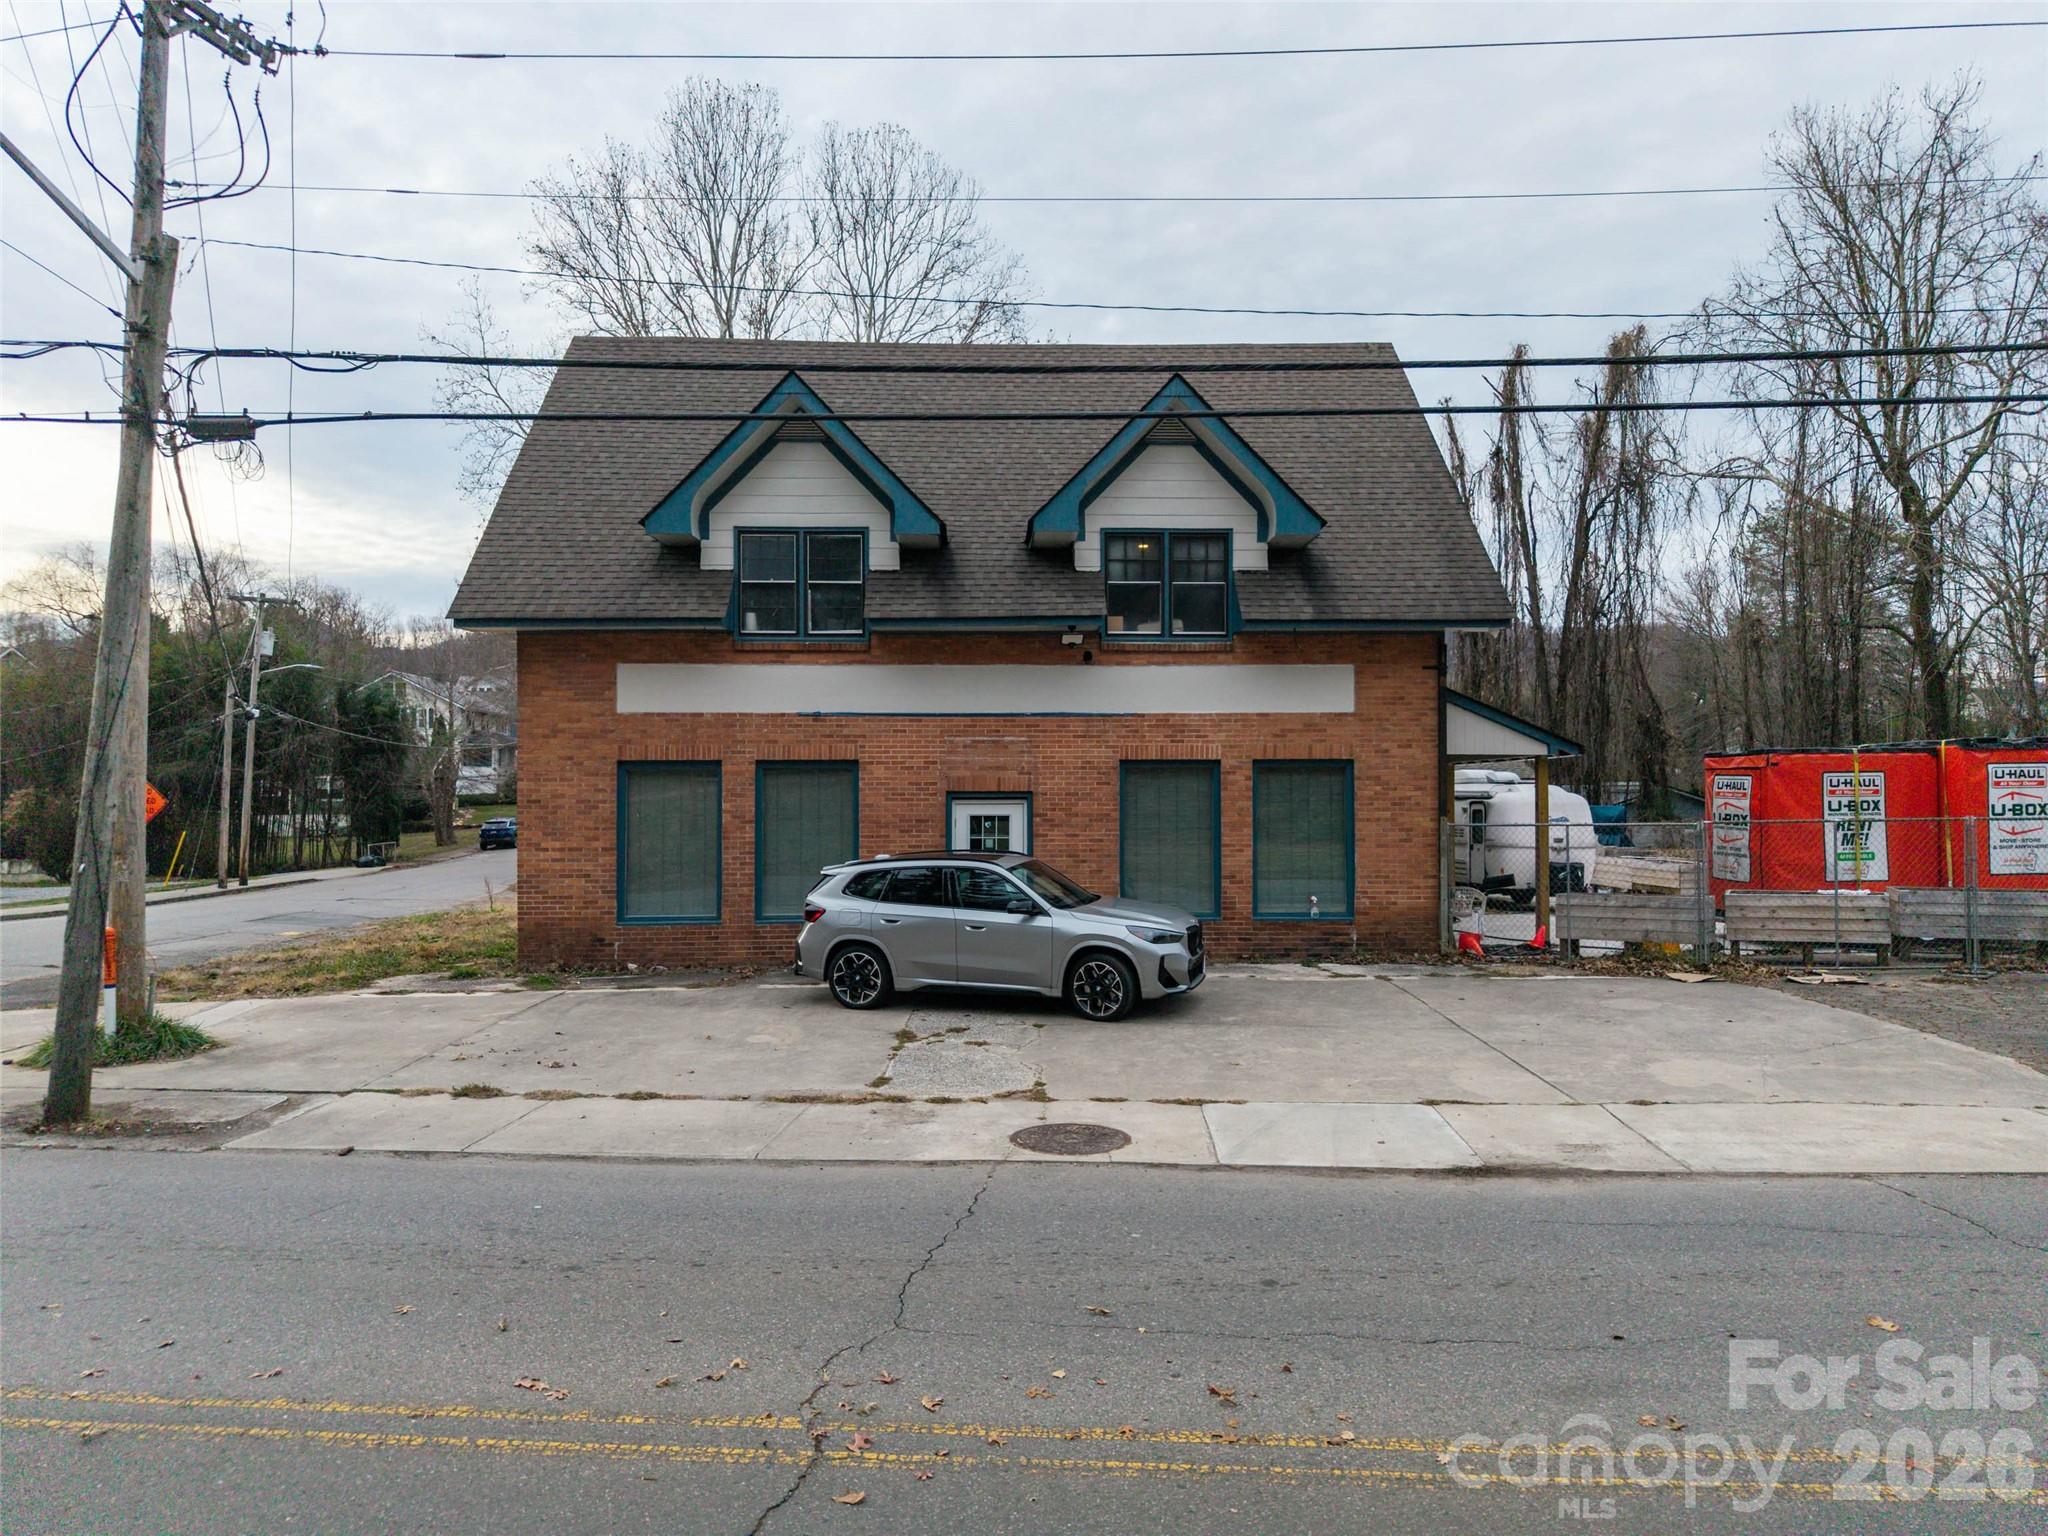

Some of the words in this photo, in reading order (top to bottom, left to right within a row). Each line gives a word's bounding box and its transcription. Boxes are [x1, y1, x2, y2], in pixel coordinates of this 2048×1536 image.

[1994, 769, 2045, 779] U-HAUL
[1717, 781, 1748, 790] U-HAUL
[1991, 802, 2048, 816] U-BOX
